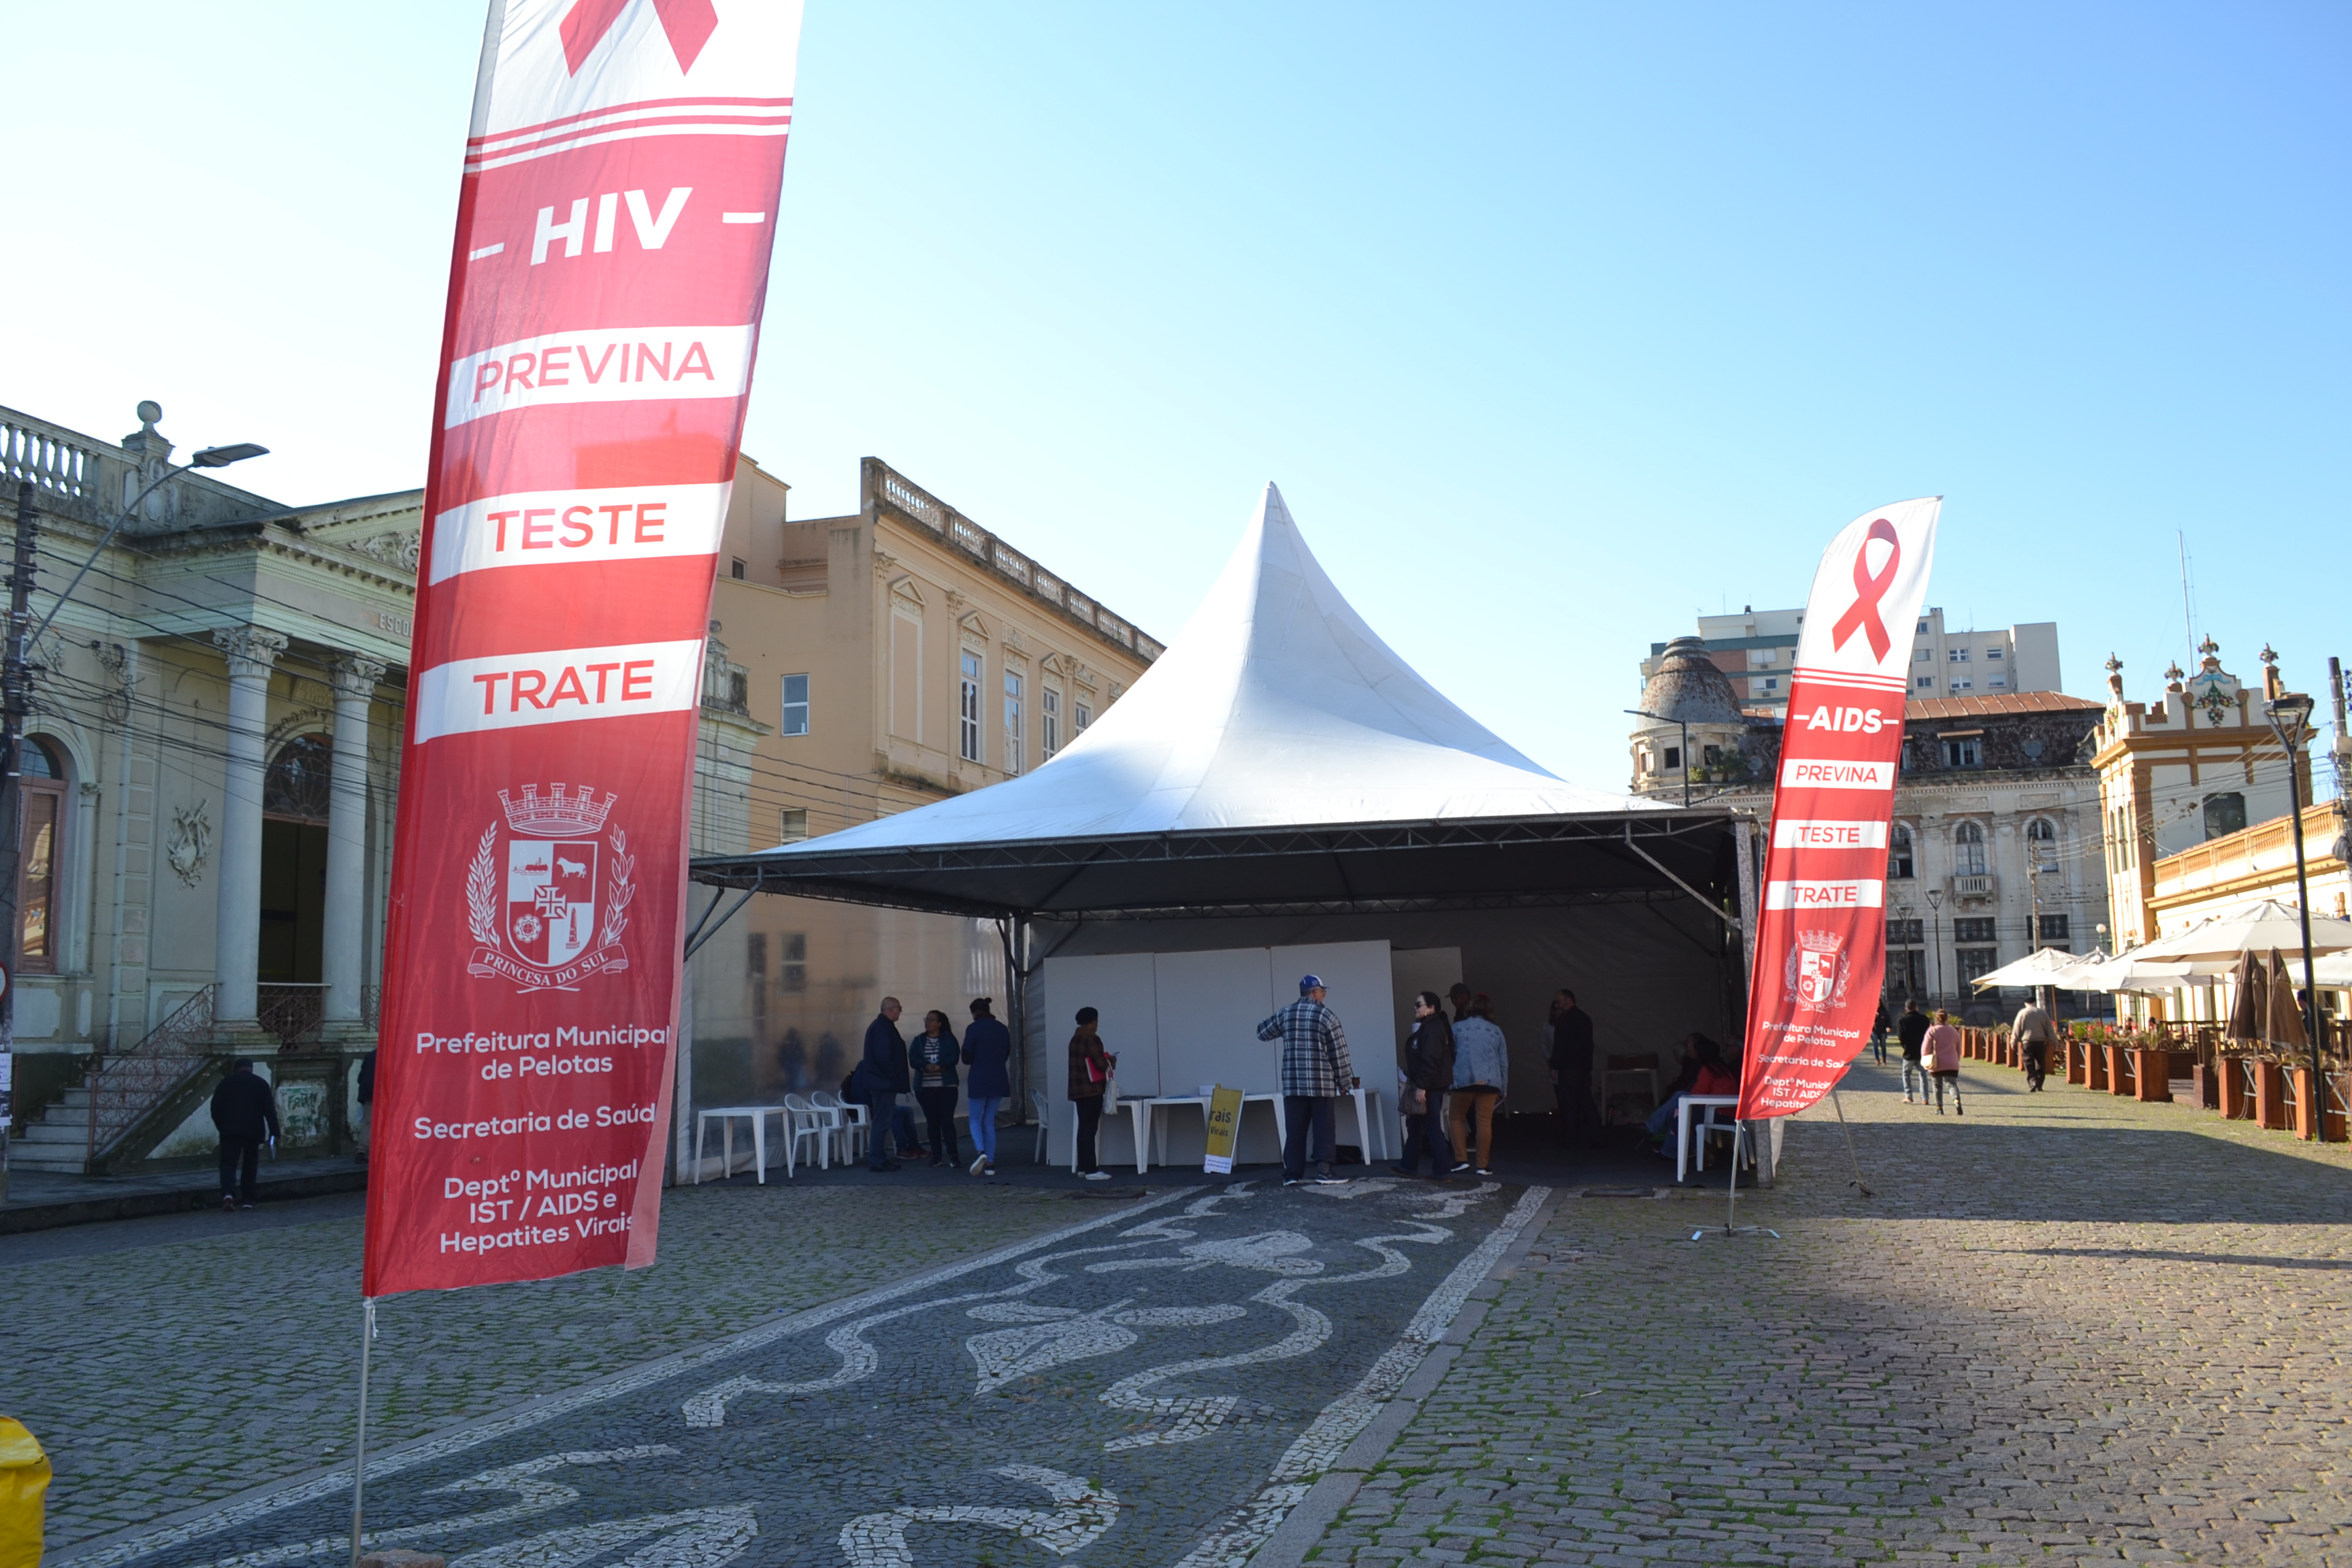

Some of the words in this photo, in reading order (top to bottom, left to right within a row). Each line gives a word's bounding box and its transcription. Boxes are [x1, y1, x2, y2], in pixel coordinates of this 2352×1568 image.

[530, 187, 693, 265] HIV
[473, 342, 715, 403] PREVINA
[487, 502, 667, 552] TESTE
[473, 659, 655, 715] TRATE
[1795, 765, 1878, 783] PREVINA
[1799, 826, 1860, 843] TESTE
[1791, 886, 1857, 902] TRATE
[484, 953, 551, 985] PRINCESA
[555, 968, 577, 984] DO
[581, 952, 609, 973] SUL
[416, 1031, 550, 1054] Prefeitura
[556, 1024, 670, 1048] Municipal
[1763, 1022, 1812, 1034] Prefeitura
[1814, 1025, 1860, 1039] Municipal
[1784, 1034, 1796, 1043] de
[1797, 1034, 1836, 1047] Pelotas
[481, 1059, 512, 1080] de
[519, 1054, 613, 1077] Pelotas
[1758, 1054, 1809, 1066] Secretaria
[1811, 1058, 1824, 1067] de
[1773, 1088, 1791, 1097] IST
[414, 1112, 551, 1139] Secretaria
[557, 1109, 589, 1130] de
[526, 1158, 637, 1191] Municipal
[470, 1200, 513, 1224] IST
[519, 1196, 532, 1221] /
[537, 1190, 599, 1217] AIDS
[603, 1192, 617, 1208] e
[440, 1226, 570, 1255] Hepatites
